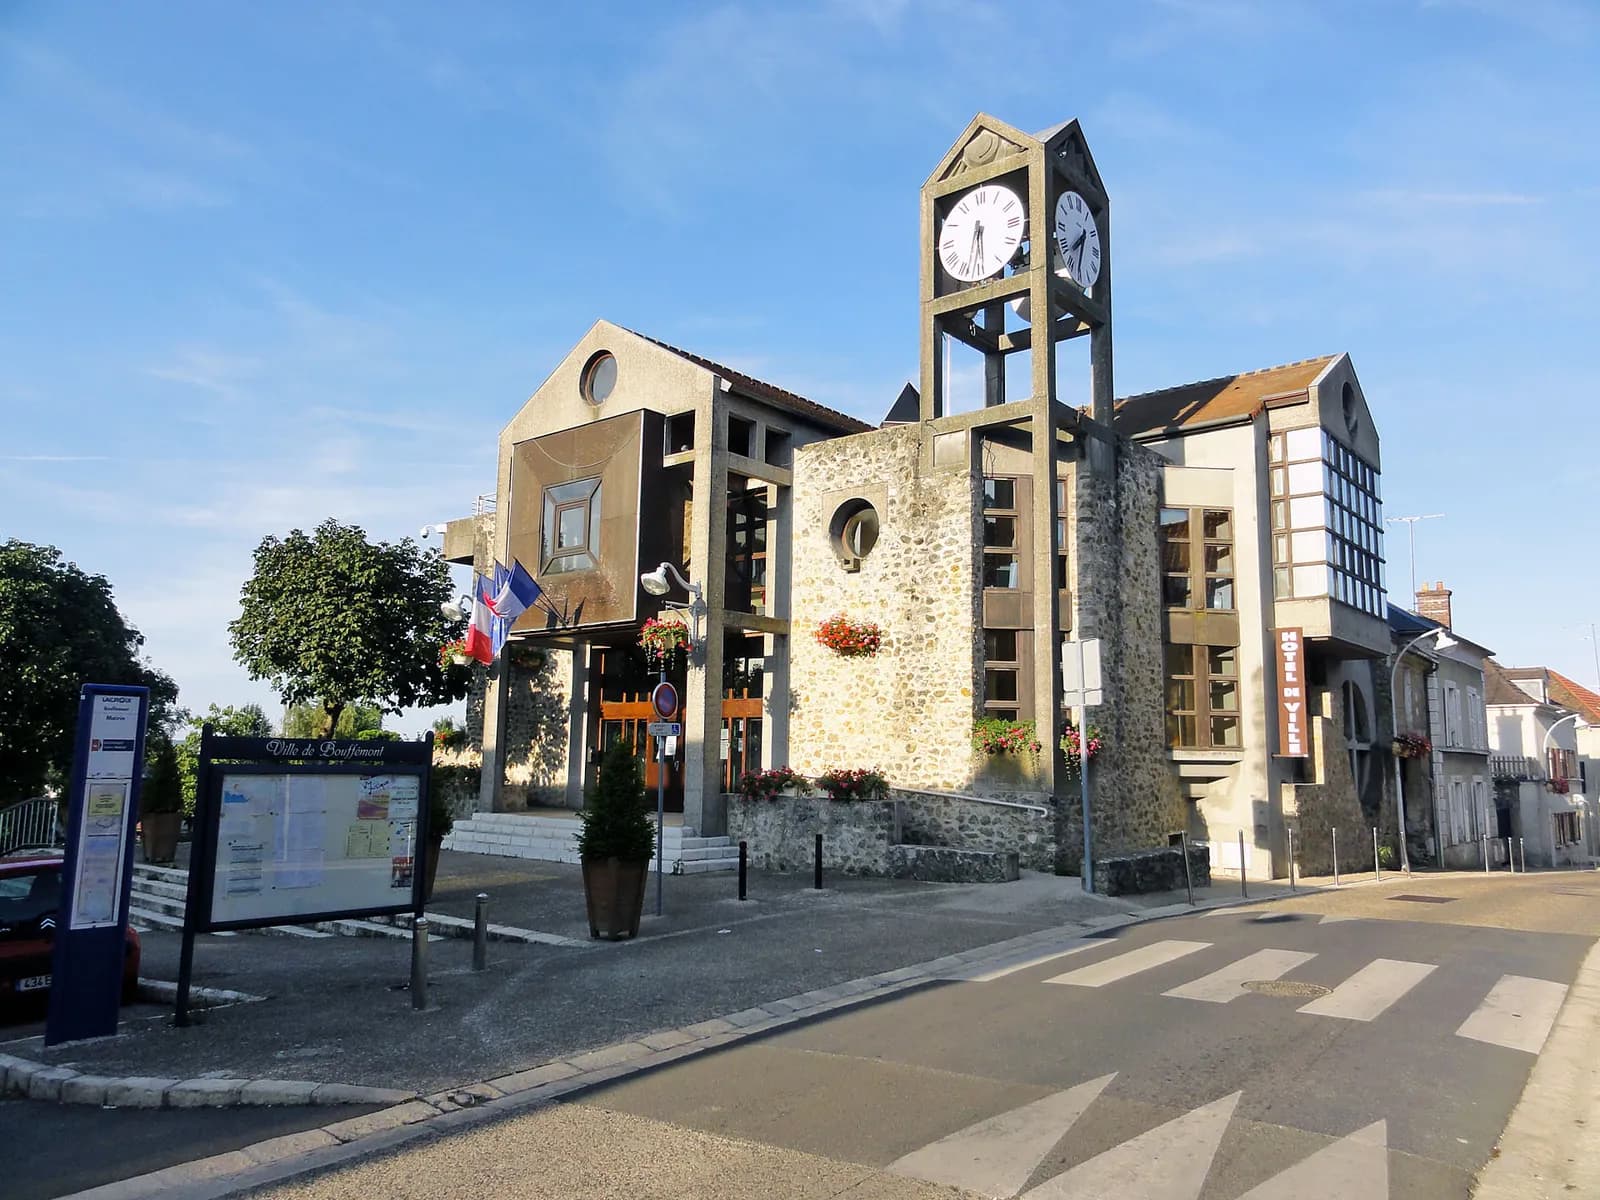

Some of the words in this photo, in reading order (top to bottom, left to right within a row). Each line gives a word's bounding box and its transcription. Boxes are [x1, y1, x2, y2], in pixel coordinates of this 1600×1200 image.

[1281, 631, 1298, 682] HOTEL
[1283, 687, 1300, 697] DE
[1283, 702, 1301, 754] VILLE
[266, 739, 299, 756] Ville
[302, 743, 315, 756] de
[320, 741, 385, 759] Bouffémont
